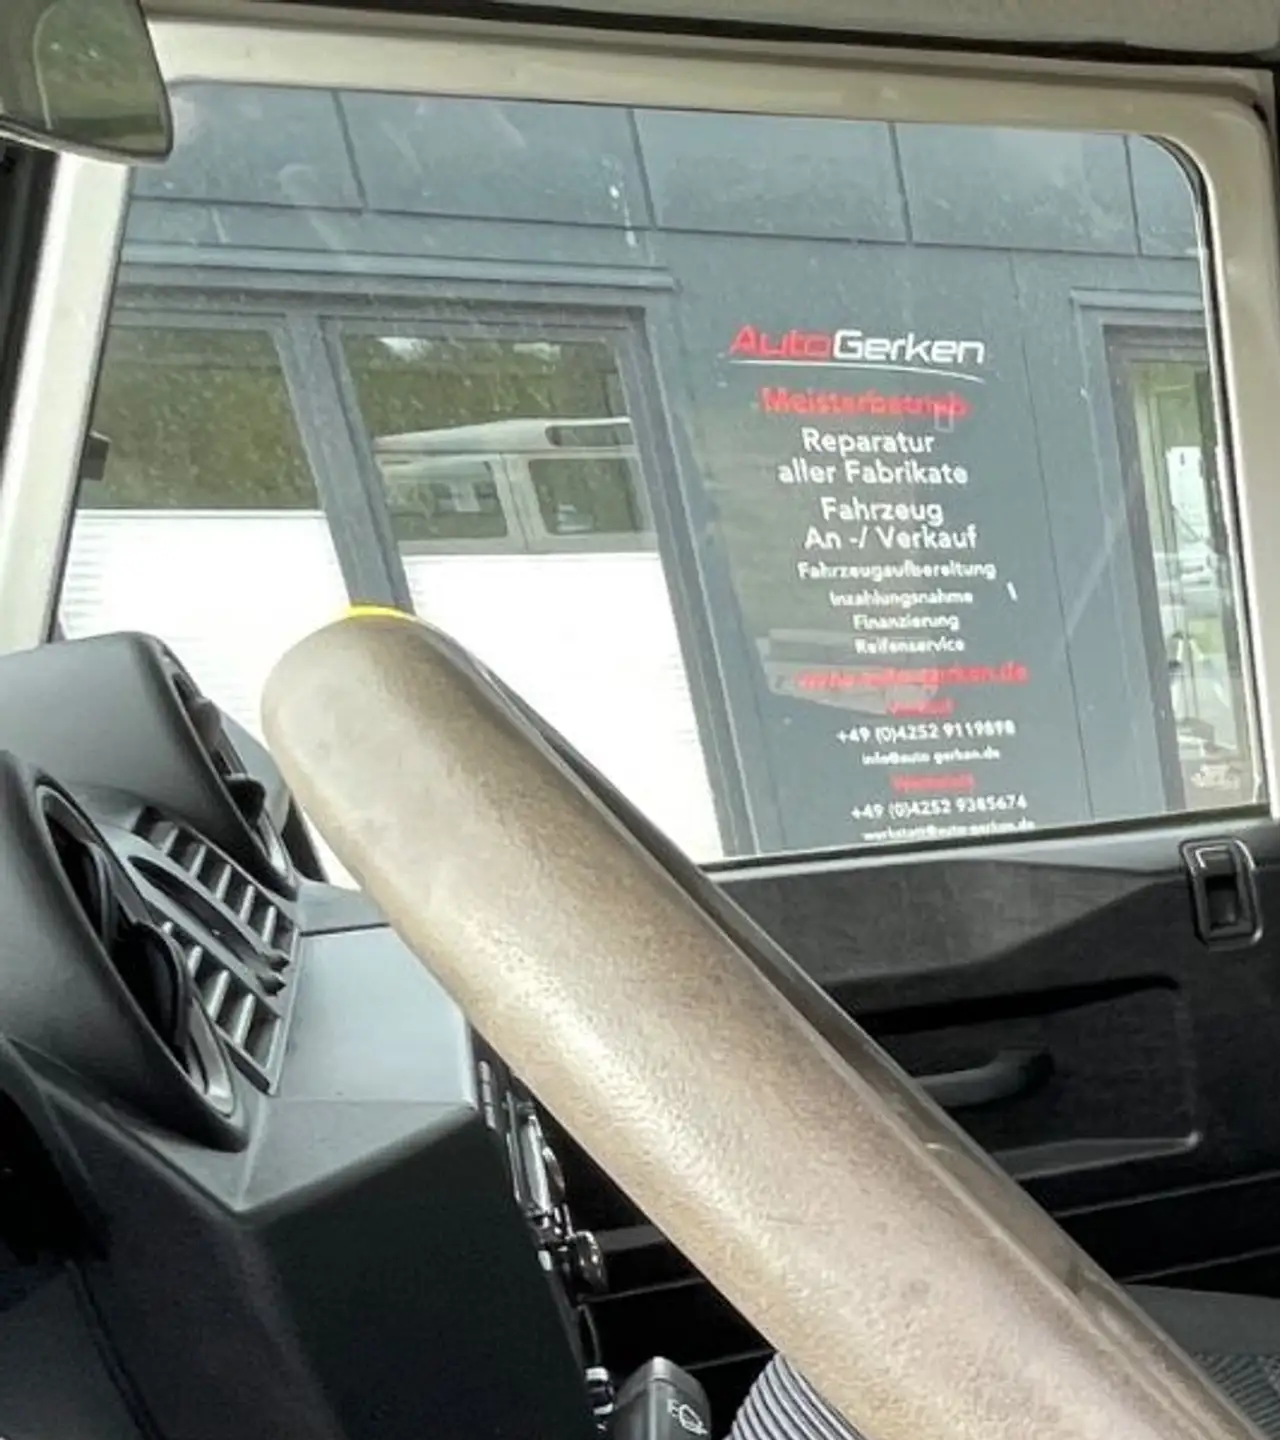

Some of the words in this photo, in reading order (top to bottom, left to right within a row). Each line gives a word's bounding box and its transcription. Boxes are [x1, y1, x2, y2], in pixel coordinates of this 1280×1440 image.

[730, 325, 986, 364] AutoGerken
[801, 427, 935, 456] Reparatur
[778, 458, 836, 485] aller
[846, 459, 968, 485] Fabrikate
[820, 497, 945, 527] Fahrzeug
[804, 527, 841, 550] An
[875, 524, 977, 551] Verkauf
[797, 560, 997, 581] Fahrzeugaufbereitung
[852, 613, 961, 631] Finanzierung
[854, 636, 966, 654] Reifenservice
[836, 728, 870, 744] +49
[851, 804, 883, 820] +49
